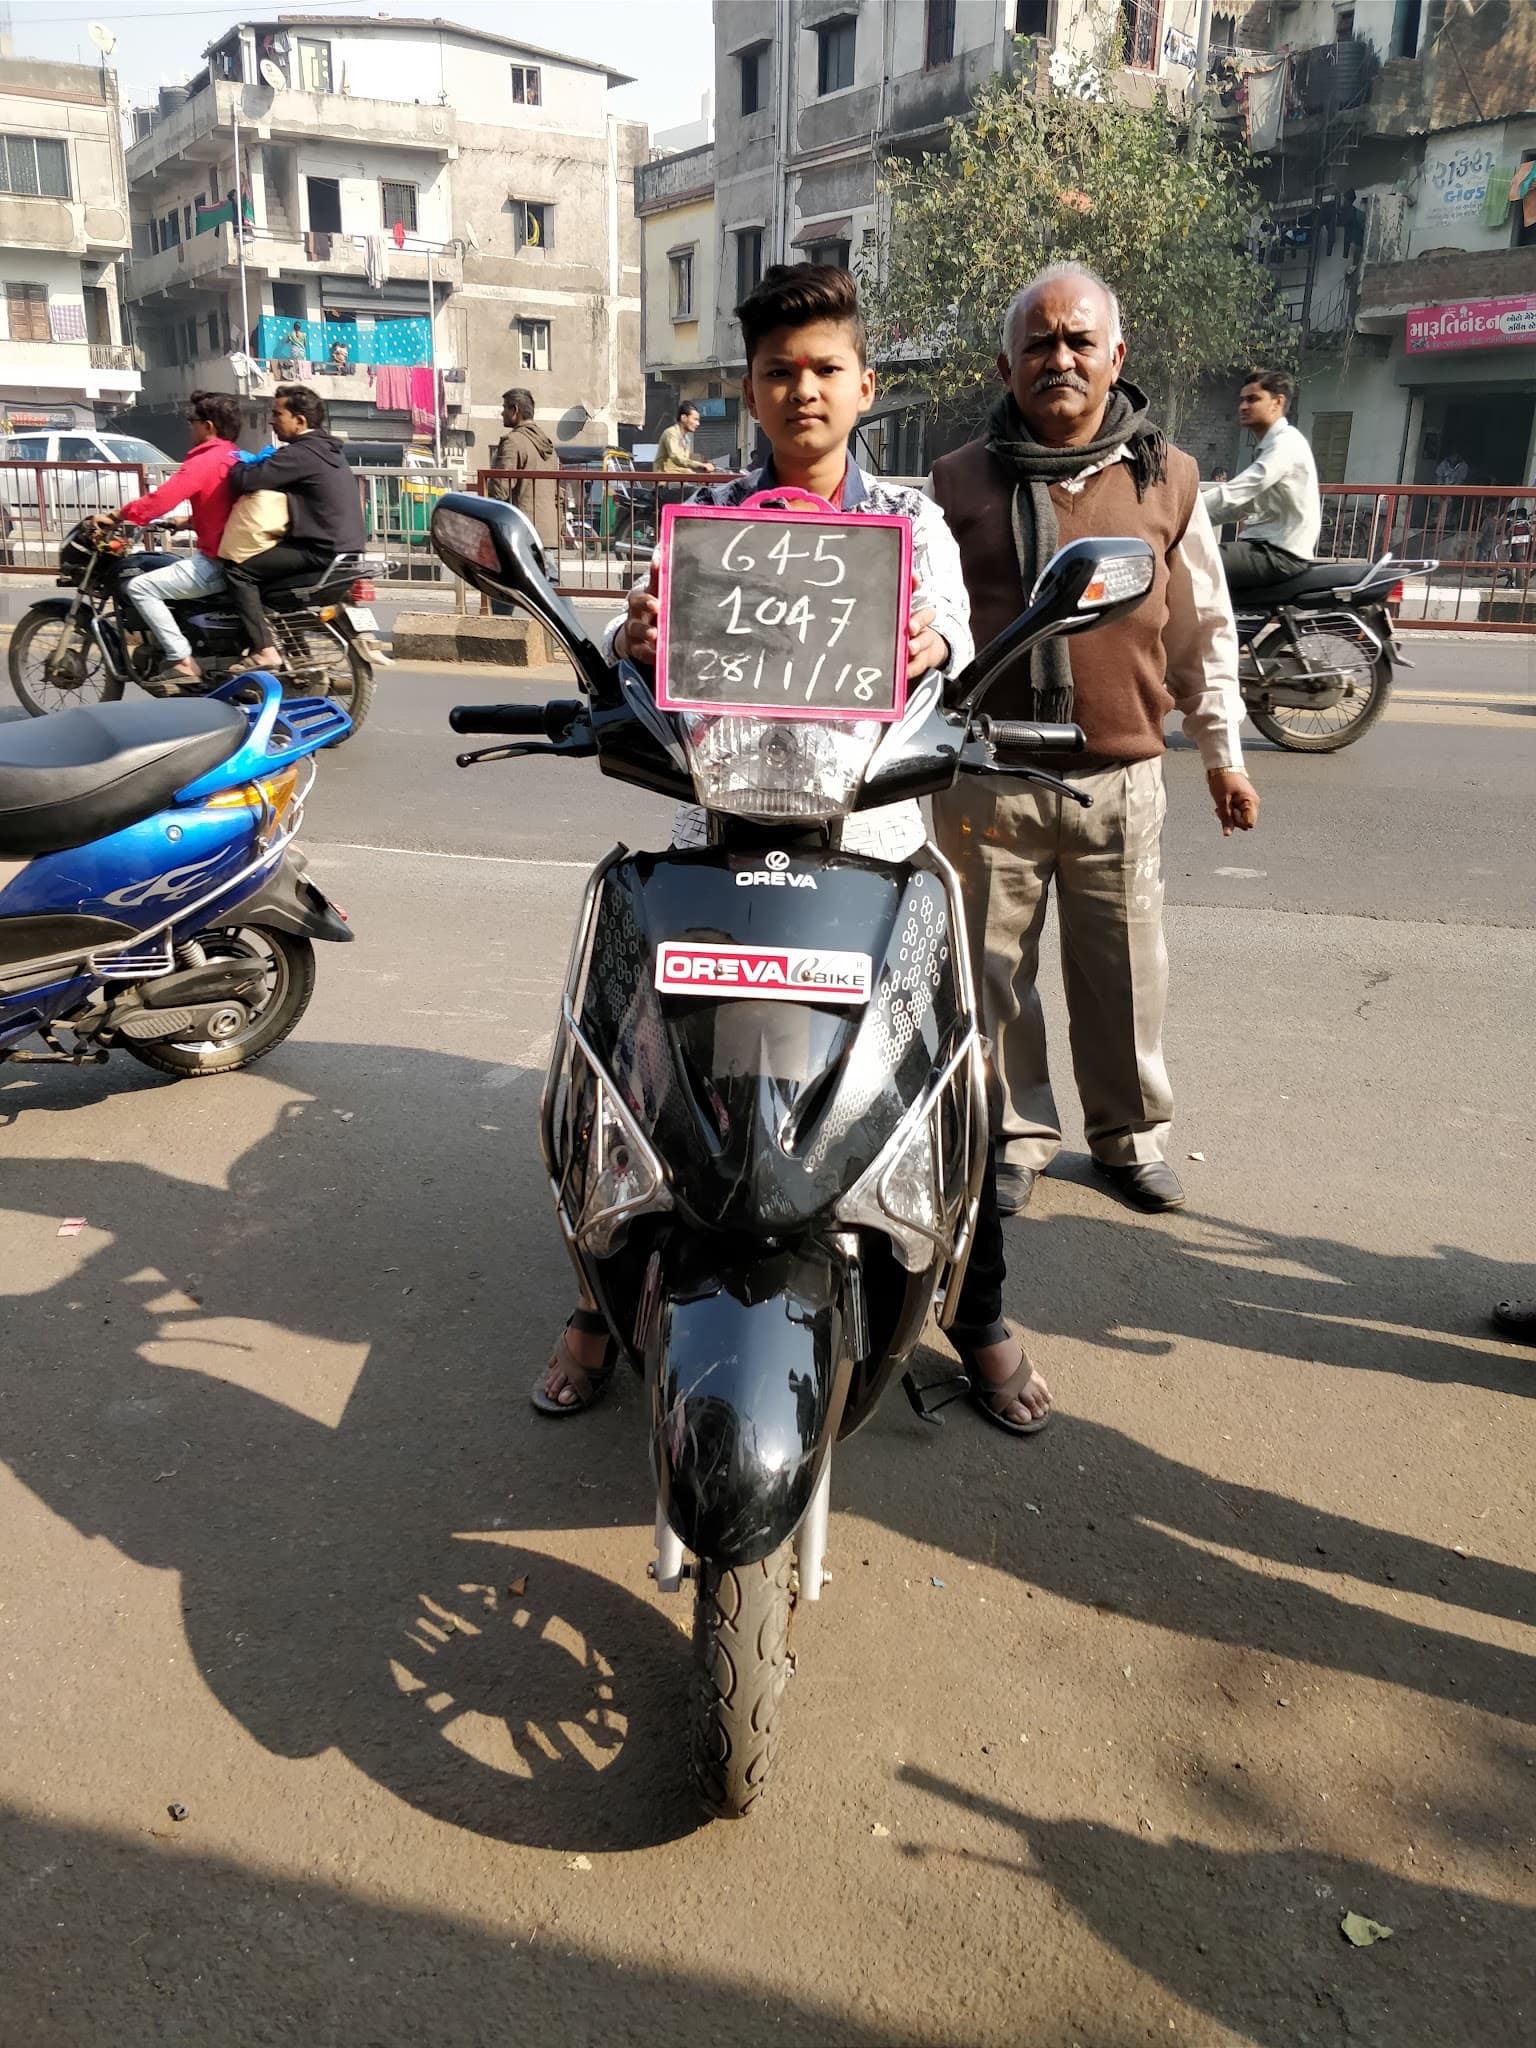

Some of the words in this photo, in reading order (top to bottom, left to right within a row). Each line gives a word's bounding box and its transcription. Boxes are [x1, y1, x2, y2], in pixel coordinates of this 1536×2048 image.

[721, 525, 847, 587] 645
[718, 586, 857, 648] 1047
[735, 871, 818, 889] OREVA
[665, 956, 788, 985] OREVA
